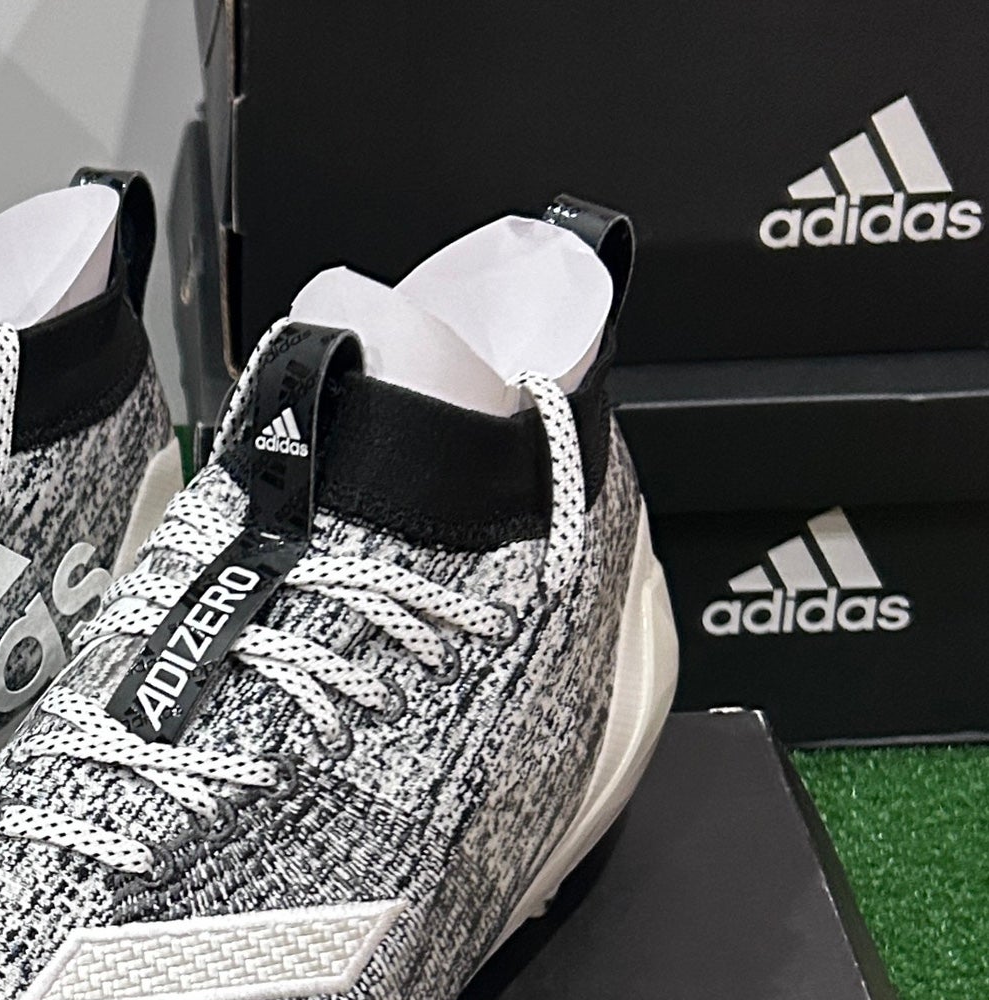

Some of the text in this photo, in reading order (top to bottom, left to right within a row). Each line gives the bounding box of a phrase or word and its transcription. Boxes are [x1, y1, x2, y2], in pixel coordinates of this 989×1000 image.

[759, 192, 982, 249] adidas
[254, 434, 309, 457] adidas
[702, 588, 910, 635] adidas
[136, 565, 261, 732] ADIZERO
